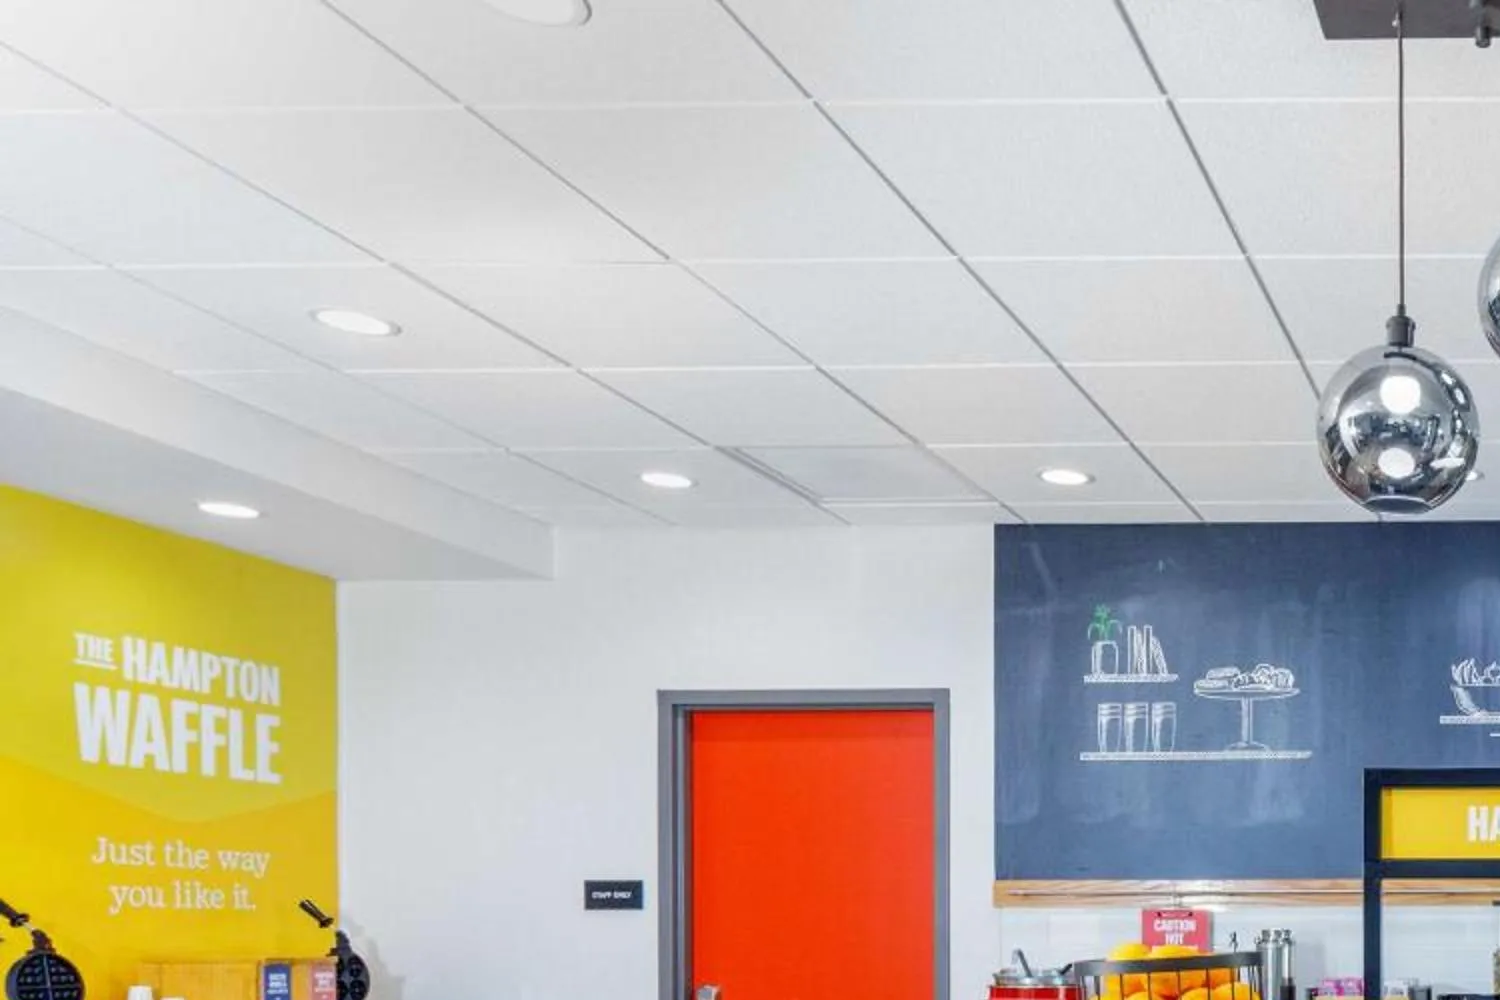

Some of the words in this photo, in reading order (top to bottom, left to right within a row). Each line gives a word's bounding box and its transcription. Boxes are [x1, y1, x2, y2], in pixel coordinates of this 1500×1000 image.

[74, 632, 114, 661] THE
[122, 635, 280, 706] HAMPTON
[73, 682, 283, 785] WAFFLE
[91, 836, 156, 867] Just
[163, 838, 209, 870] the
[218, 849, 271, 880] way
[107, 884, 166, 916] you
[173, 877, 225, 911] like
[232, 883, 257, 911] it.
[1153, 919, 1197, 932] CAUTION
